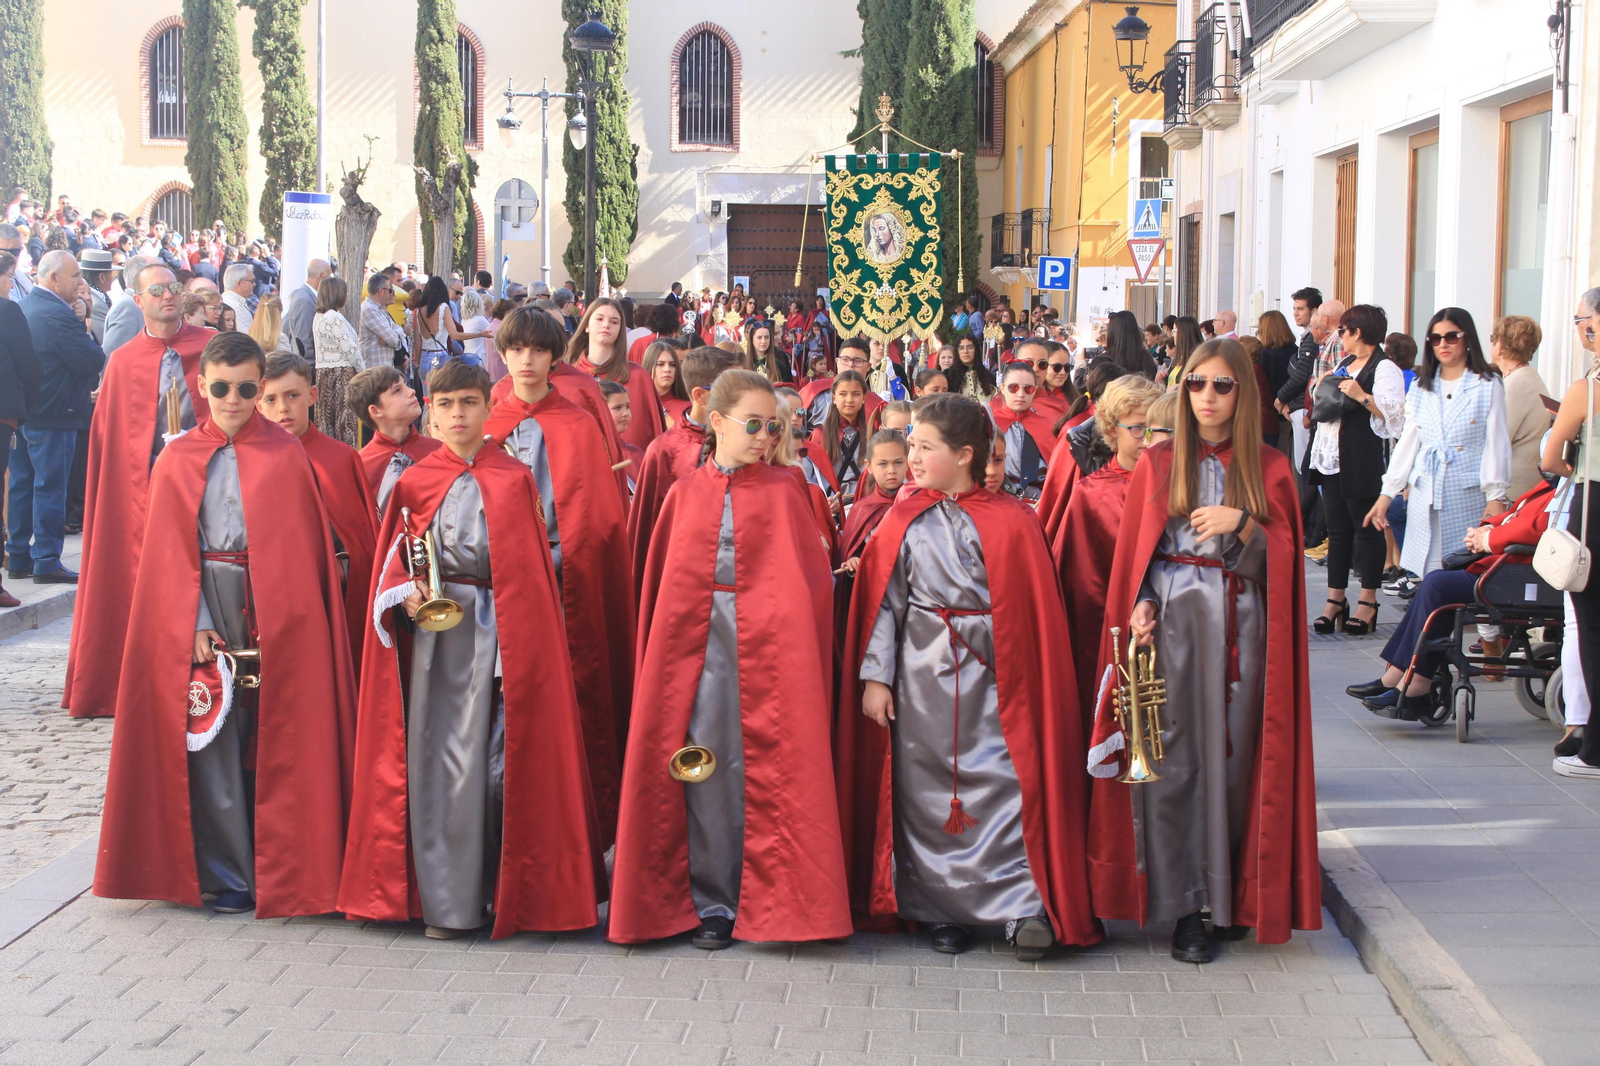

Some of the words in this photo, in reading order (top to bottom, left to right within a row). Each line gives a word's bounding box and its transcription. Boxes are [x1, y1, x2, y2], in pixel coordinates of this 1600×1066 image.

[1135, 245, 1147, 253] CEDA
[1149, 245, 1155, 253] EL
[1138, 254, 1151, 262] PASO
[1044, 260, 1065, 286] P
